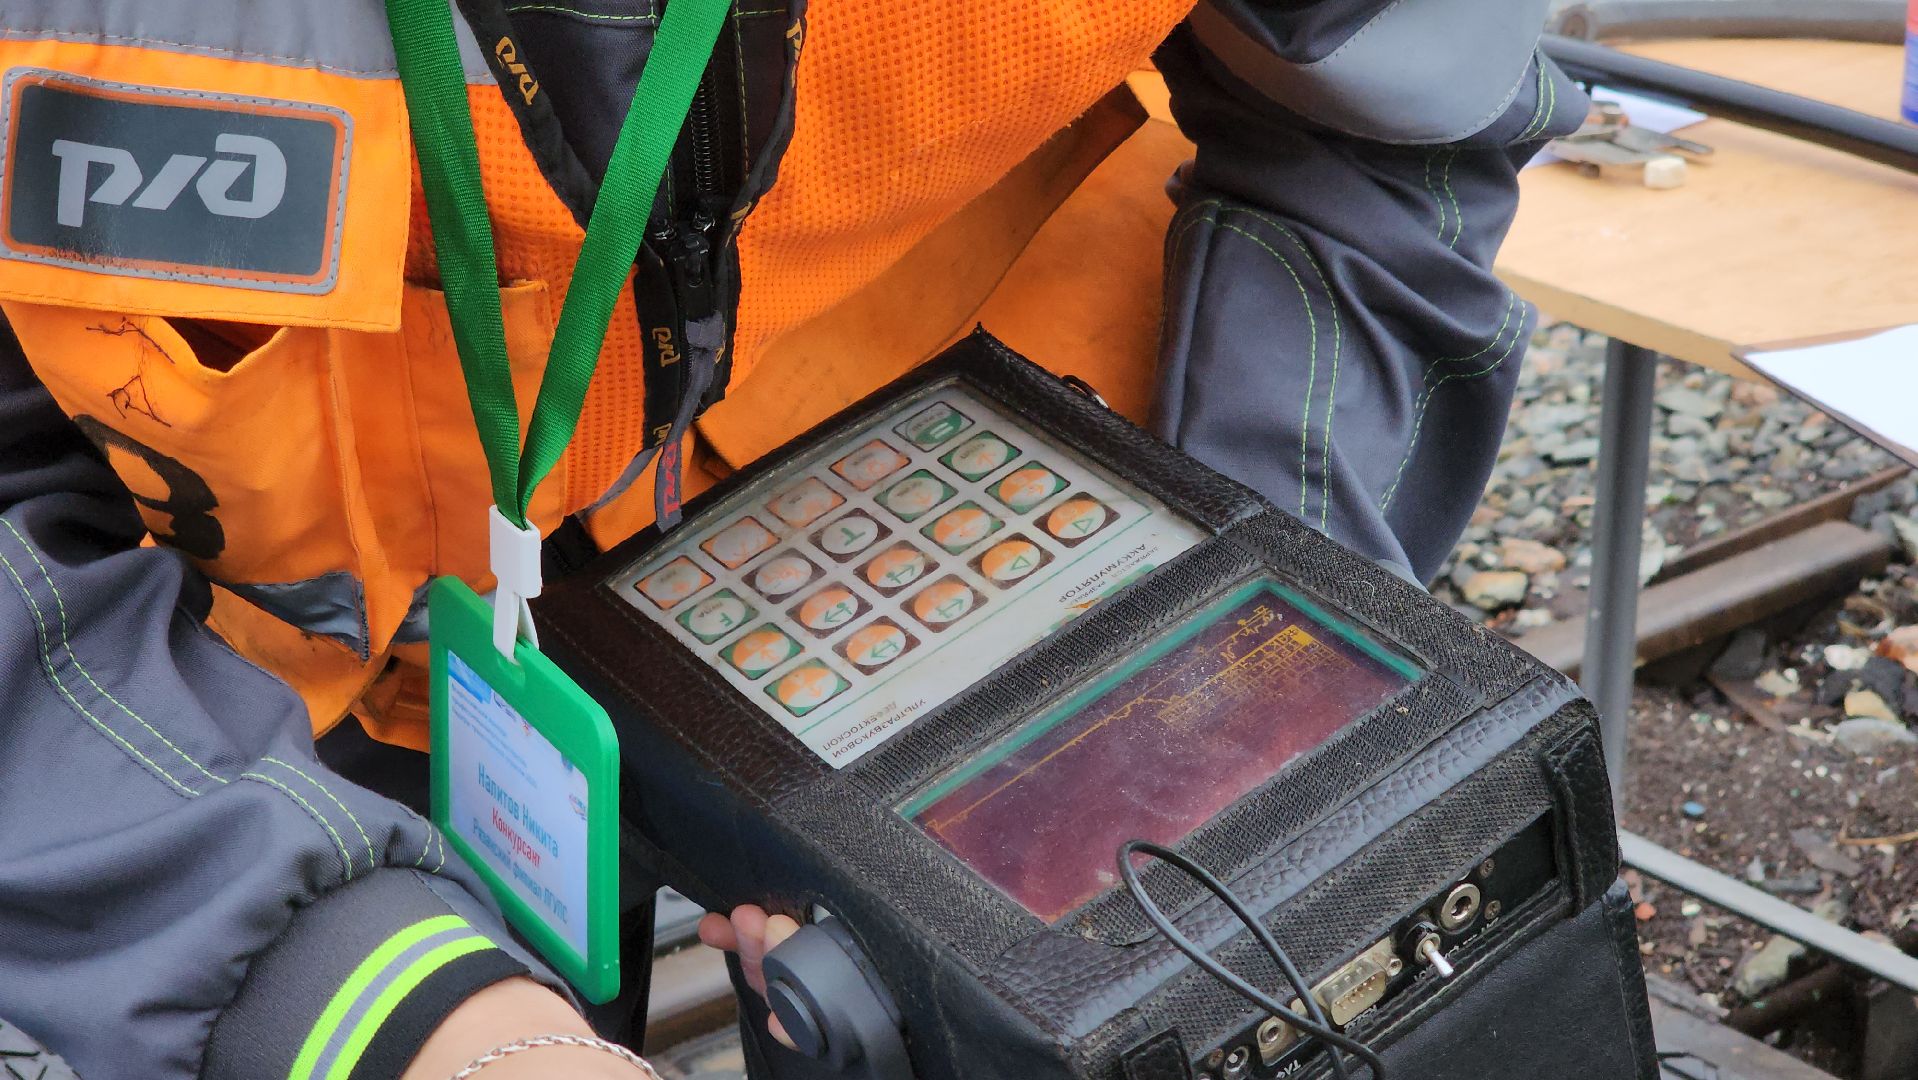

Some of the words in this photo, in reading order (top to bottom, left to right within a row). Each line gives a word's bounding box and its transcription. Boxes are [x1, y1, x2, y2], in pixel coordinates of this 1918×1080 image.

[1058, 543, 1146, 603] АККУМУЛЯТОР
[492, 807, 541, 869] Конкурсант
[522, 803, 559, 859] Никита
